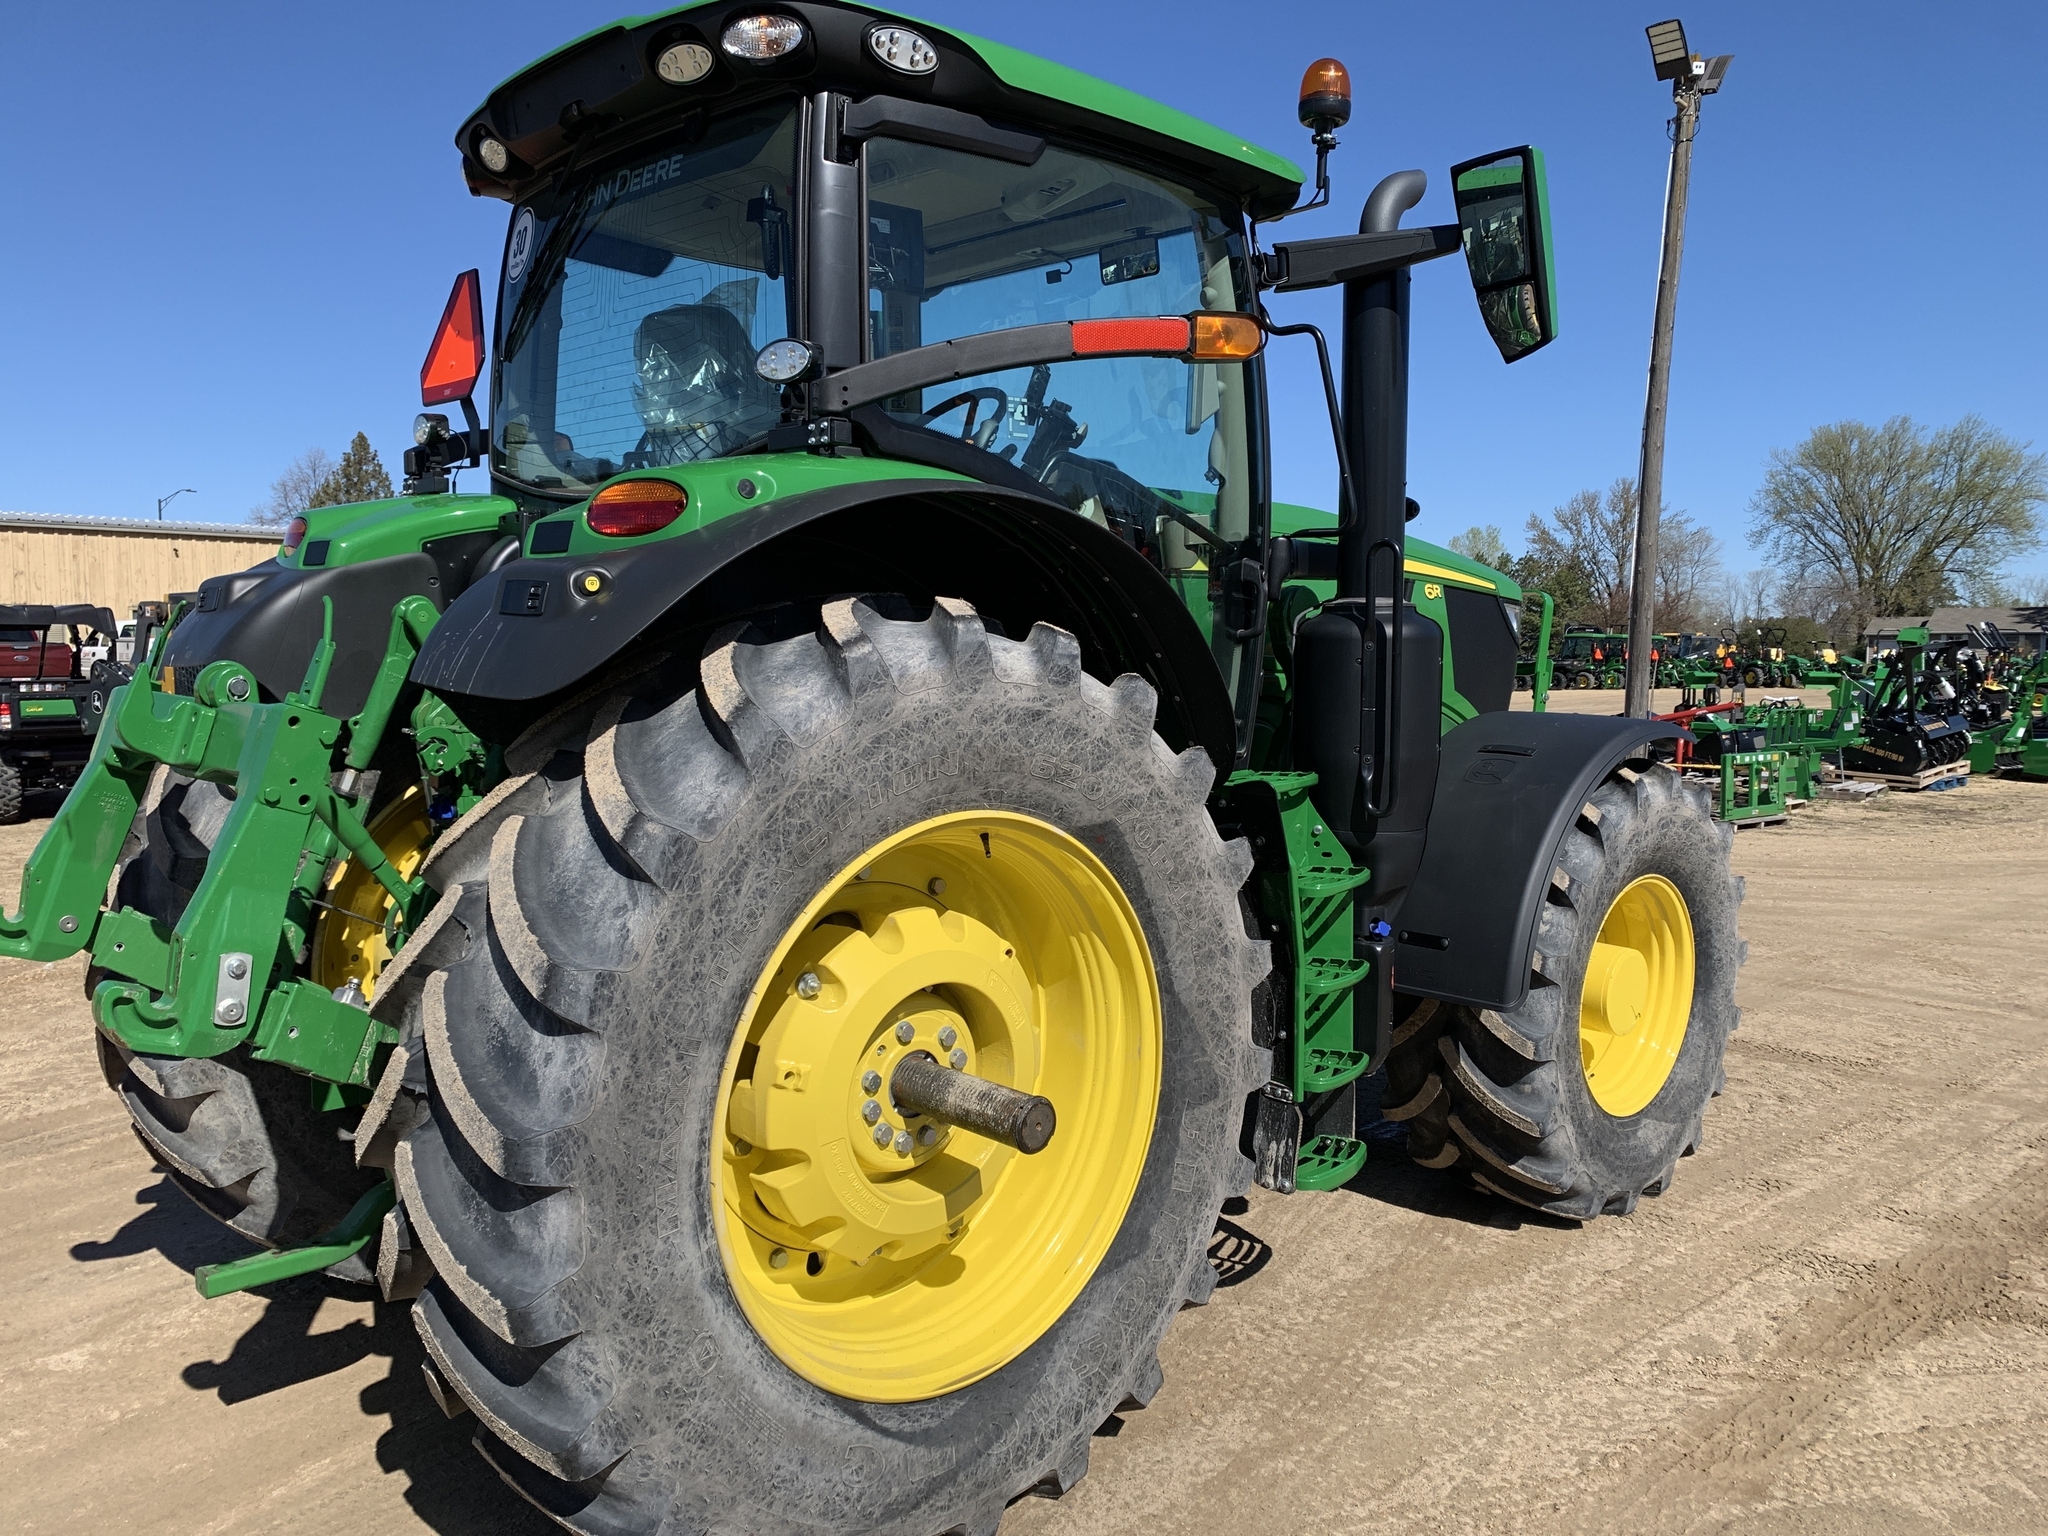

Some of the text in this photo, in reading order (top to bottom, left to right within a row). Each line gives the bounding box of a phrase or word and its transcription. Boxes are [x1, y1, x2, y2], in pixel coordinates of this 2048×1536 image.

[614, 154, 684, 198] DEERE
[513, 226, 528, 259] 30
[1424, 583, 1442, 600] 6R
[1862, 745, 1875, 755] BACK
[1030, 752, 1199, 937] 620/70R42
[656, 751, 959, 1239] MAXI TRACTION
